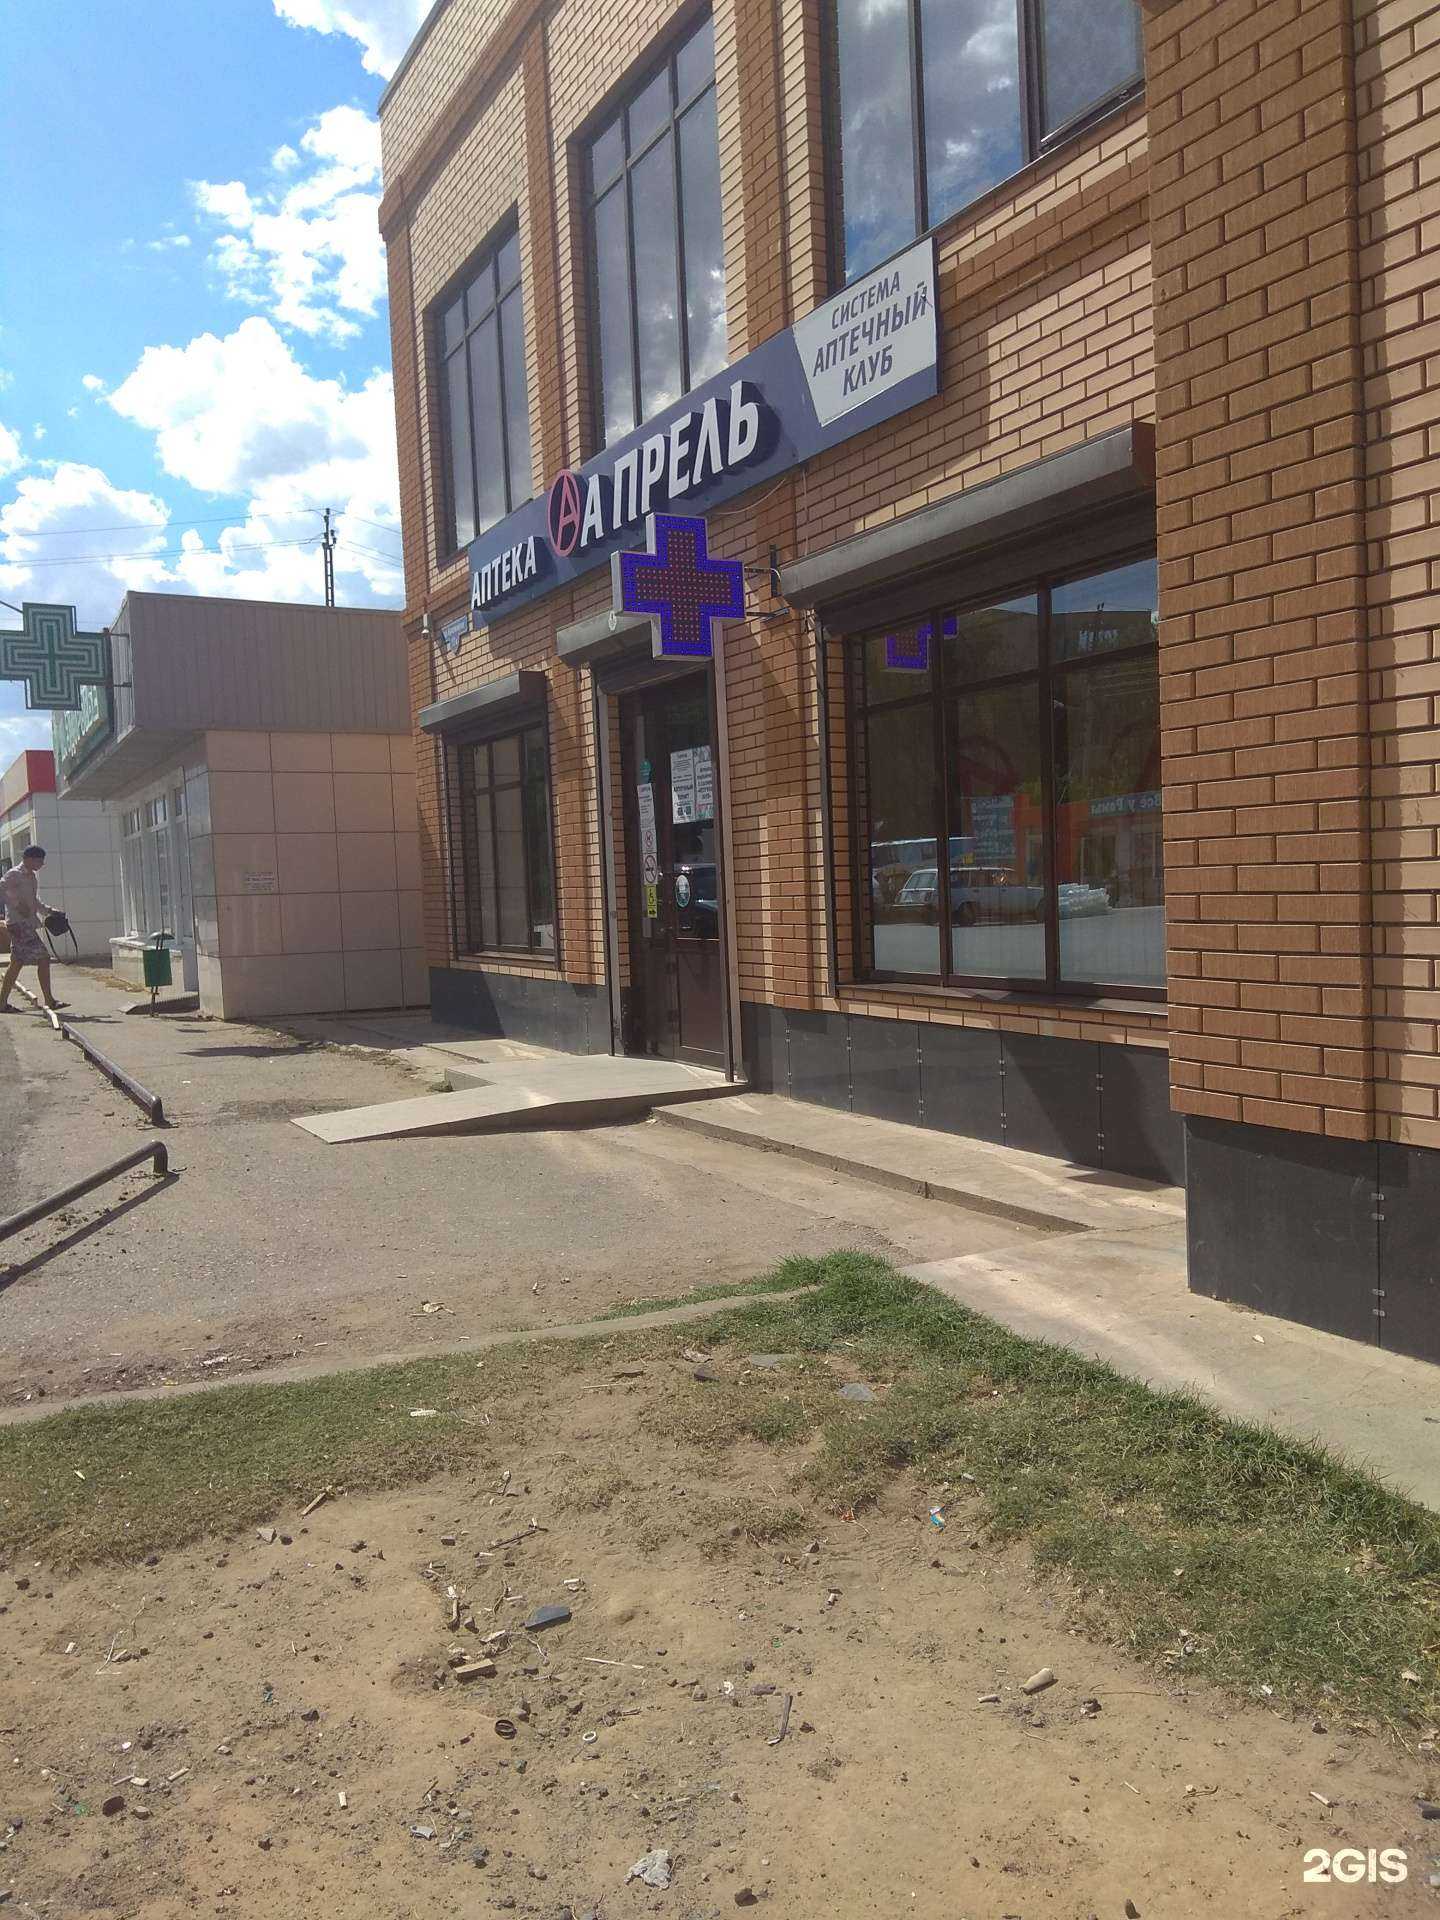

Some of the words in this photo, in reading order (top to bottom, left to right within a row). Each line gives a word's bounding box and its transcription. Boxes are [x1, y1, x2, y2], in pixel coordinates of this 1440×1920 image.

[812, 281, 928, 377] АПТЕЧНЫЙ
[831, 271, 900, 330] СИСТЕМА
[842, 344, 893, 396] КЛУБ
[471, 535, 537, 610] АПТЕКА
[580, 379, 760, 548] АПРЕЛЬ
